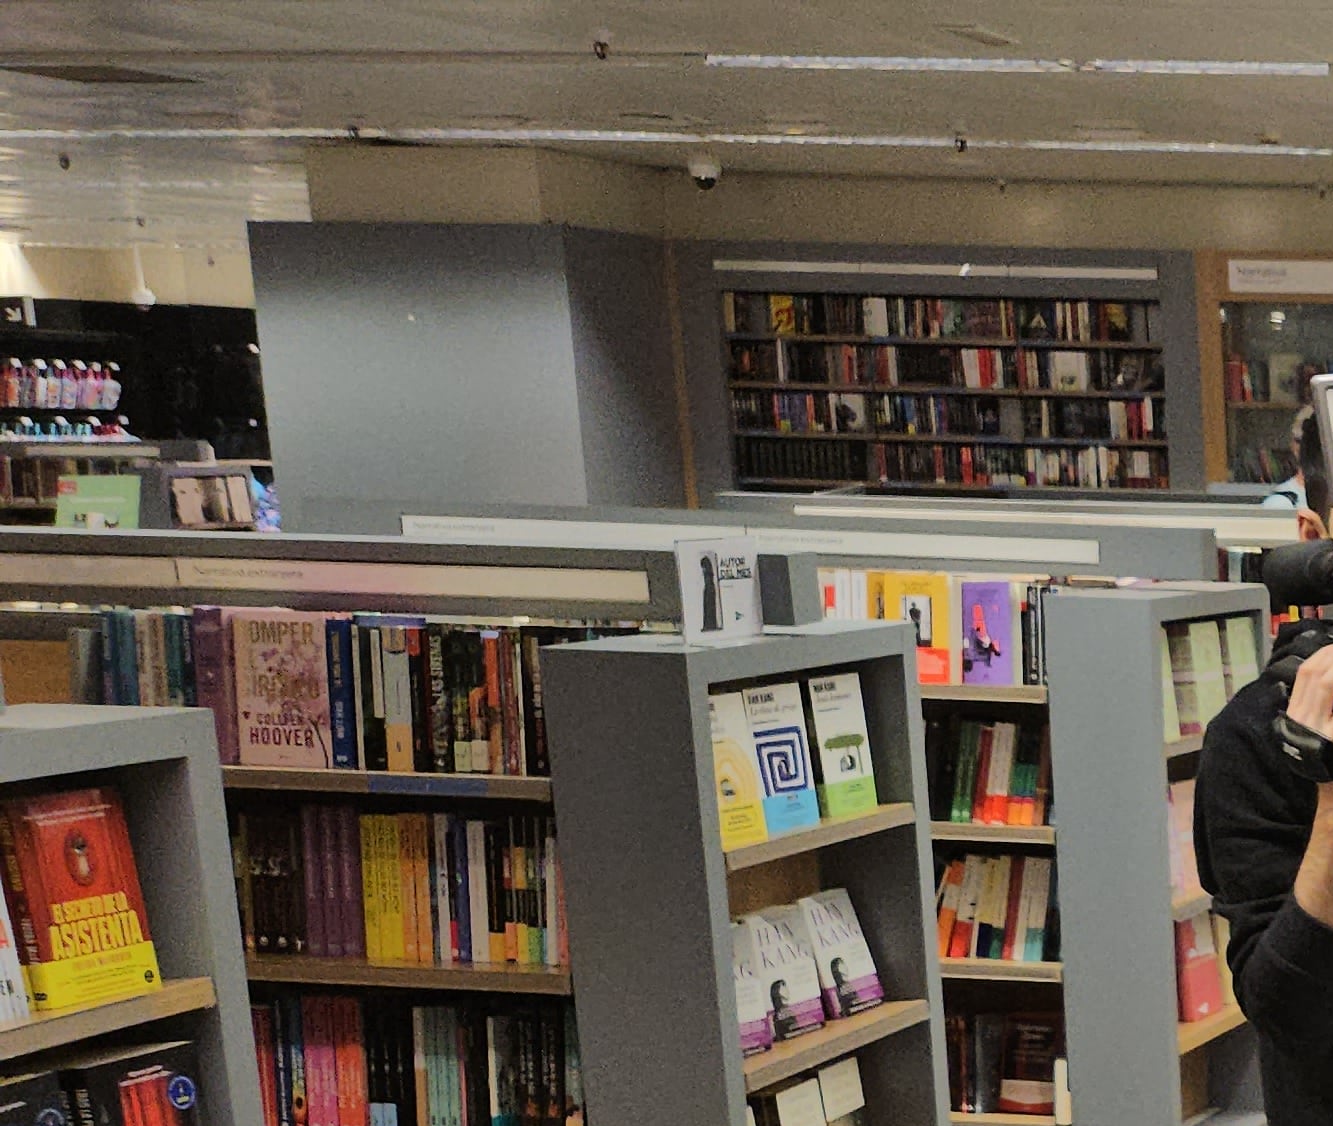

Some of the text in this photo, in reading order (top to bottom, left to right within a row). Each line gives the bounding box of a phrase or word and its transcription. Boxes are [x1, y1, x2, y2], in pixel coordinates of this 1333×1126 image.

[250, 620, 314, 645] OMPER
[250, 727, 315, 748] HOOVER
[49, 909, 144, 961] ASISTENTA
[761, 943, 810, 968] KANG
